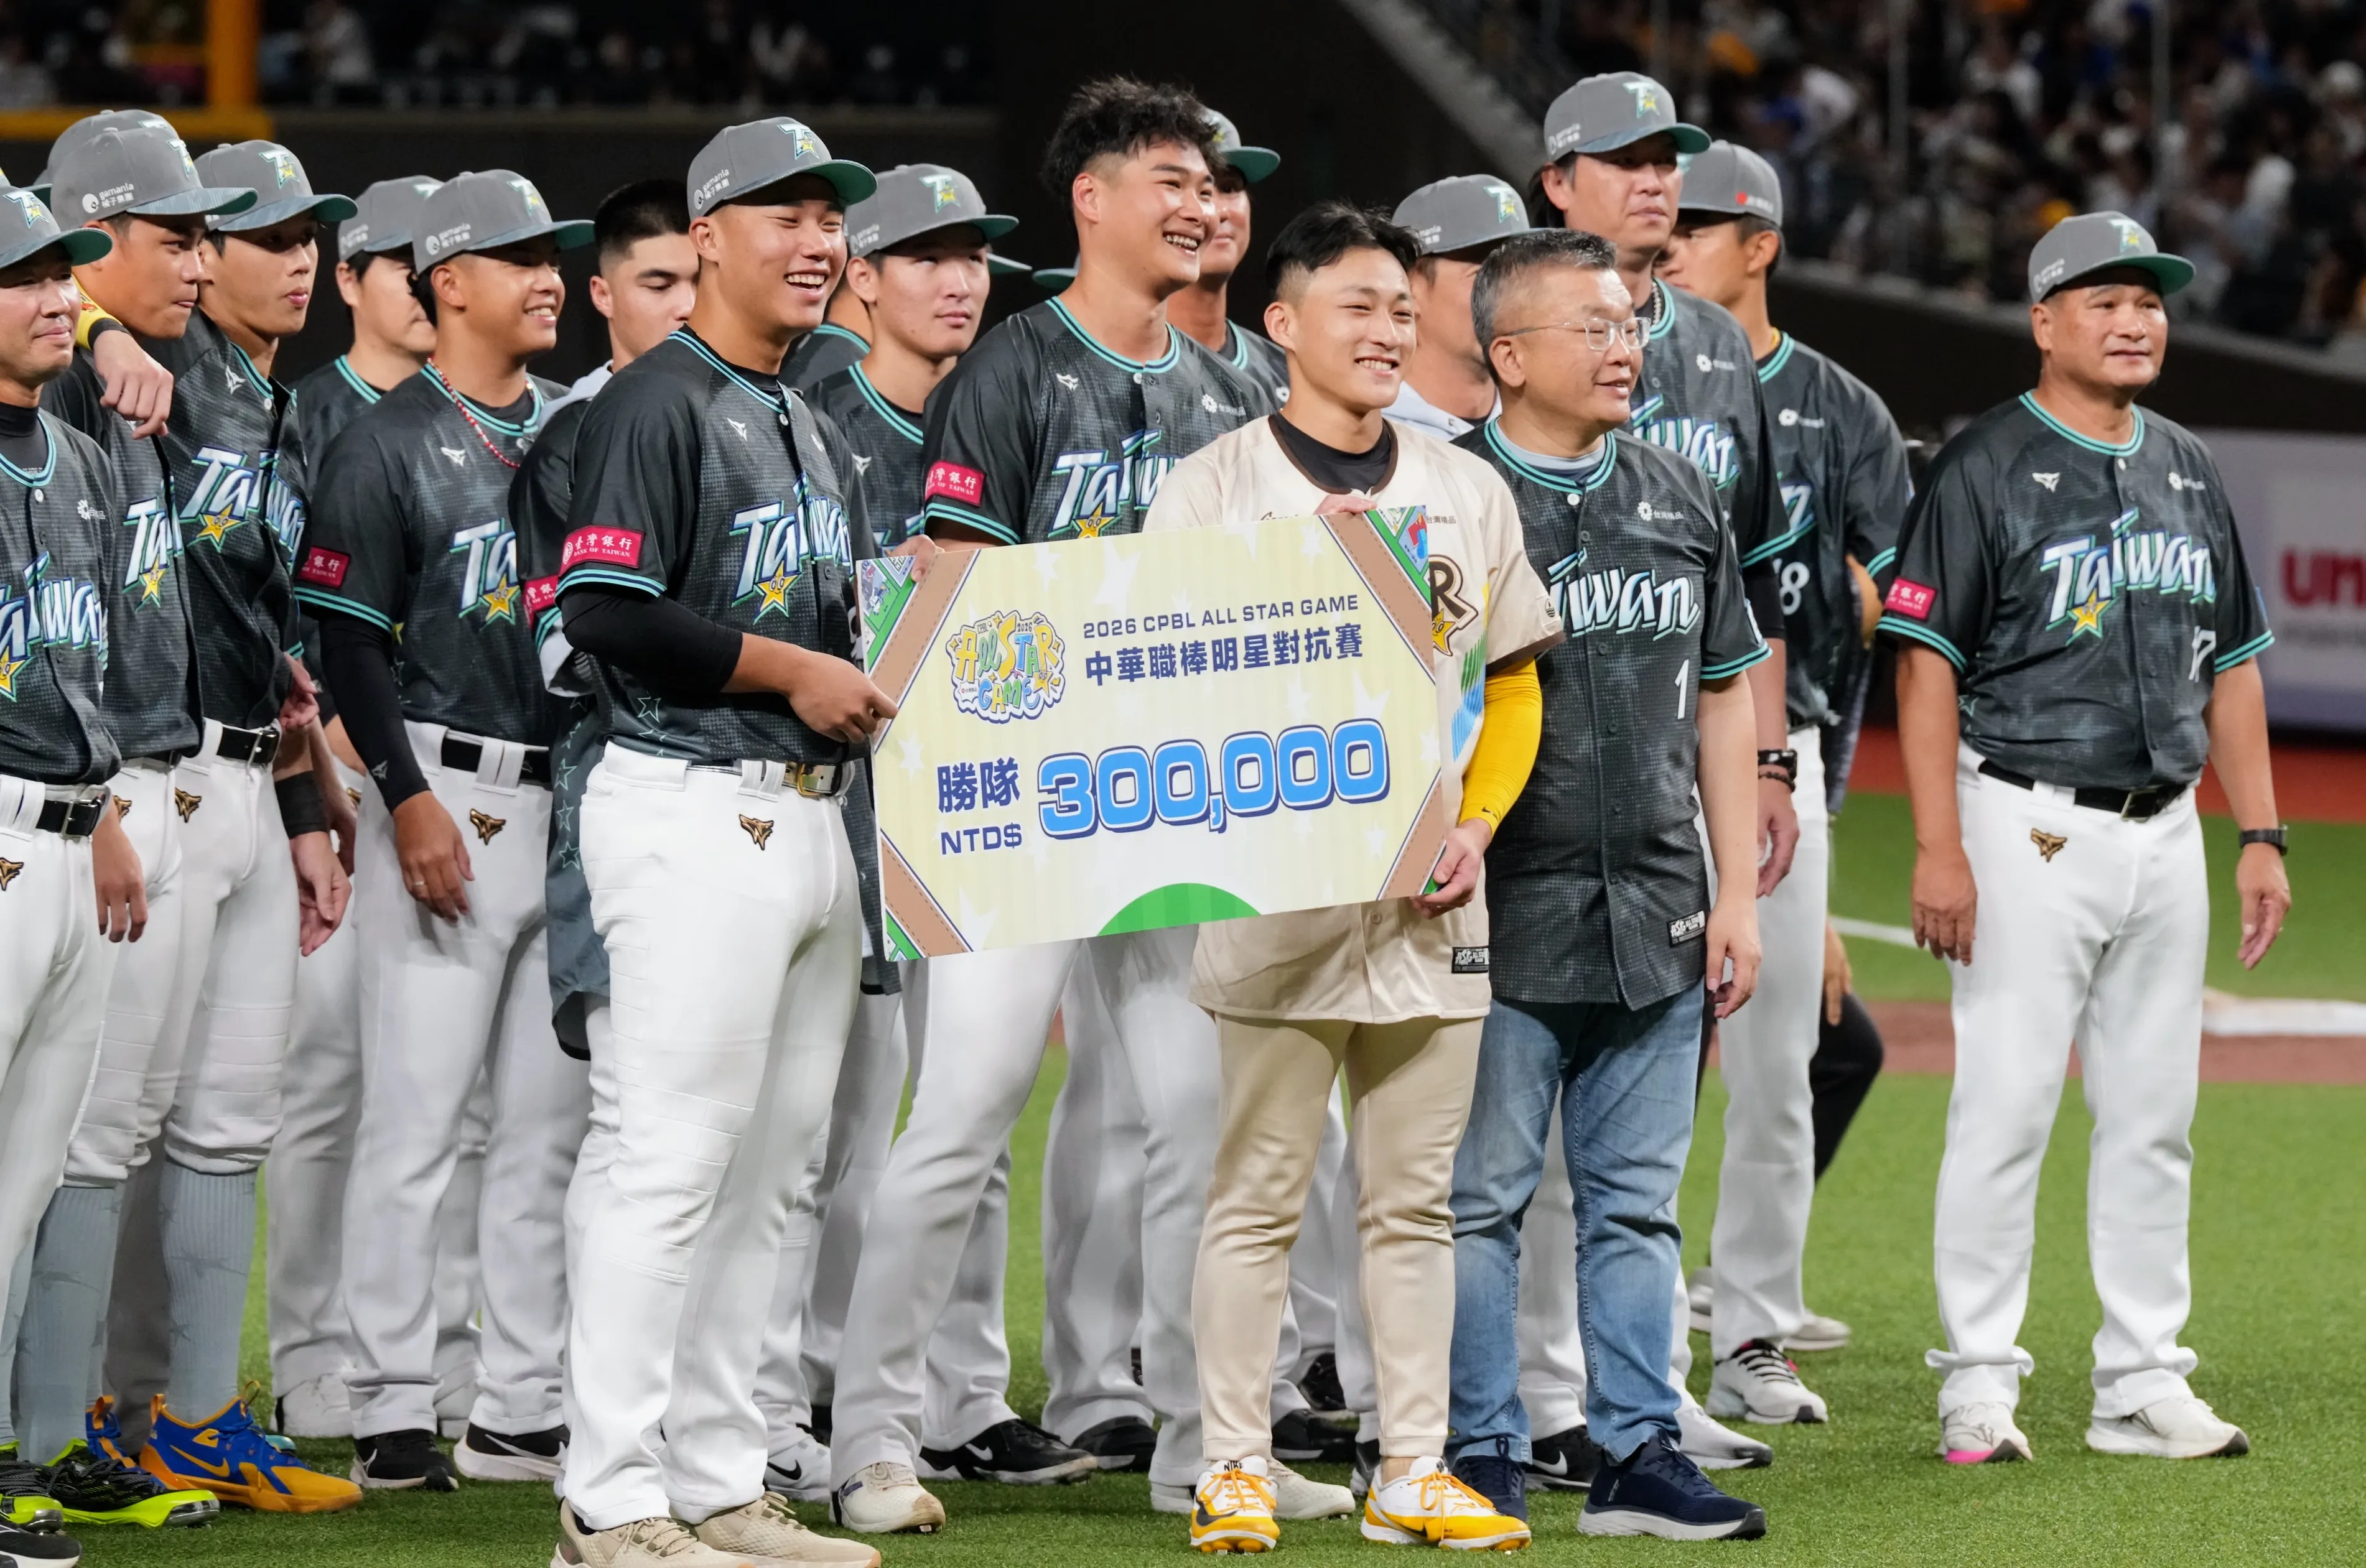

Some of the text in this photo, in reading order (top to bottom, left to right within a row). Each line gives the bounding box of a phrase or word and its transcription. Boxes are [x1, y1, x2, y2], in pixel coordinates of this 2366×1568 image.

[99, 183, 134, 200] gamania
[949, 485, 975, 495] TAIWAN
[1048, 429, 1181, 537] Taiw
[123, 476, 184, 593] Tai
[575, 533, 632, 550] 臺灣銀行
[602, 548, 630, 557] TAIWAN
[310, 555, 340, 572] 銀行
[2040, 508, 2217, 631] Taiwan
[1083, 595, 1358, 639] 2026 CPBL ALL STAR GAME
[1548, 547, 1702, 641] iwan
[998, 615, 1060, 682] STAR
[1085, 623, 1364, 687] 中華職棒明星對抗賽
[936, 757, 1022, 814] 勝隊
[1037, 718, 1390, 840] 300,000
[941, 823, 1022, 856] NTD$
[1224, 1460, 1244, 1472] NIKE
